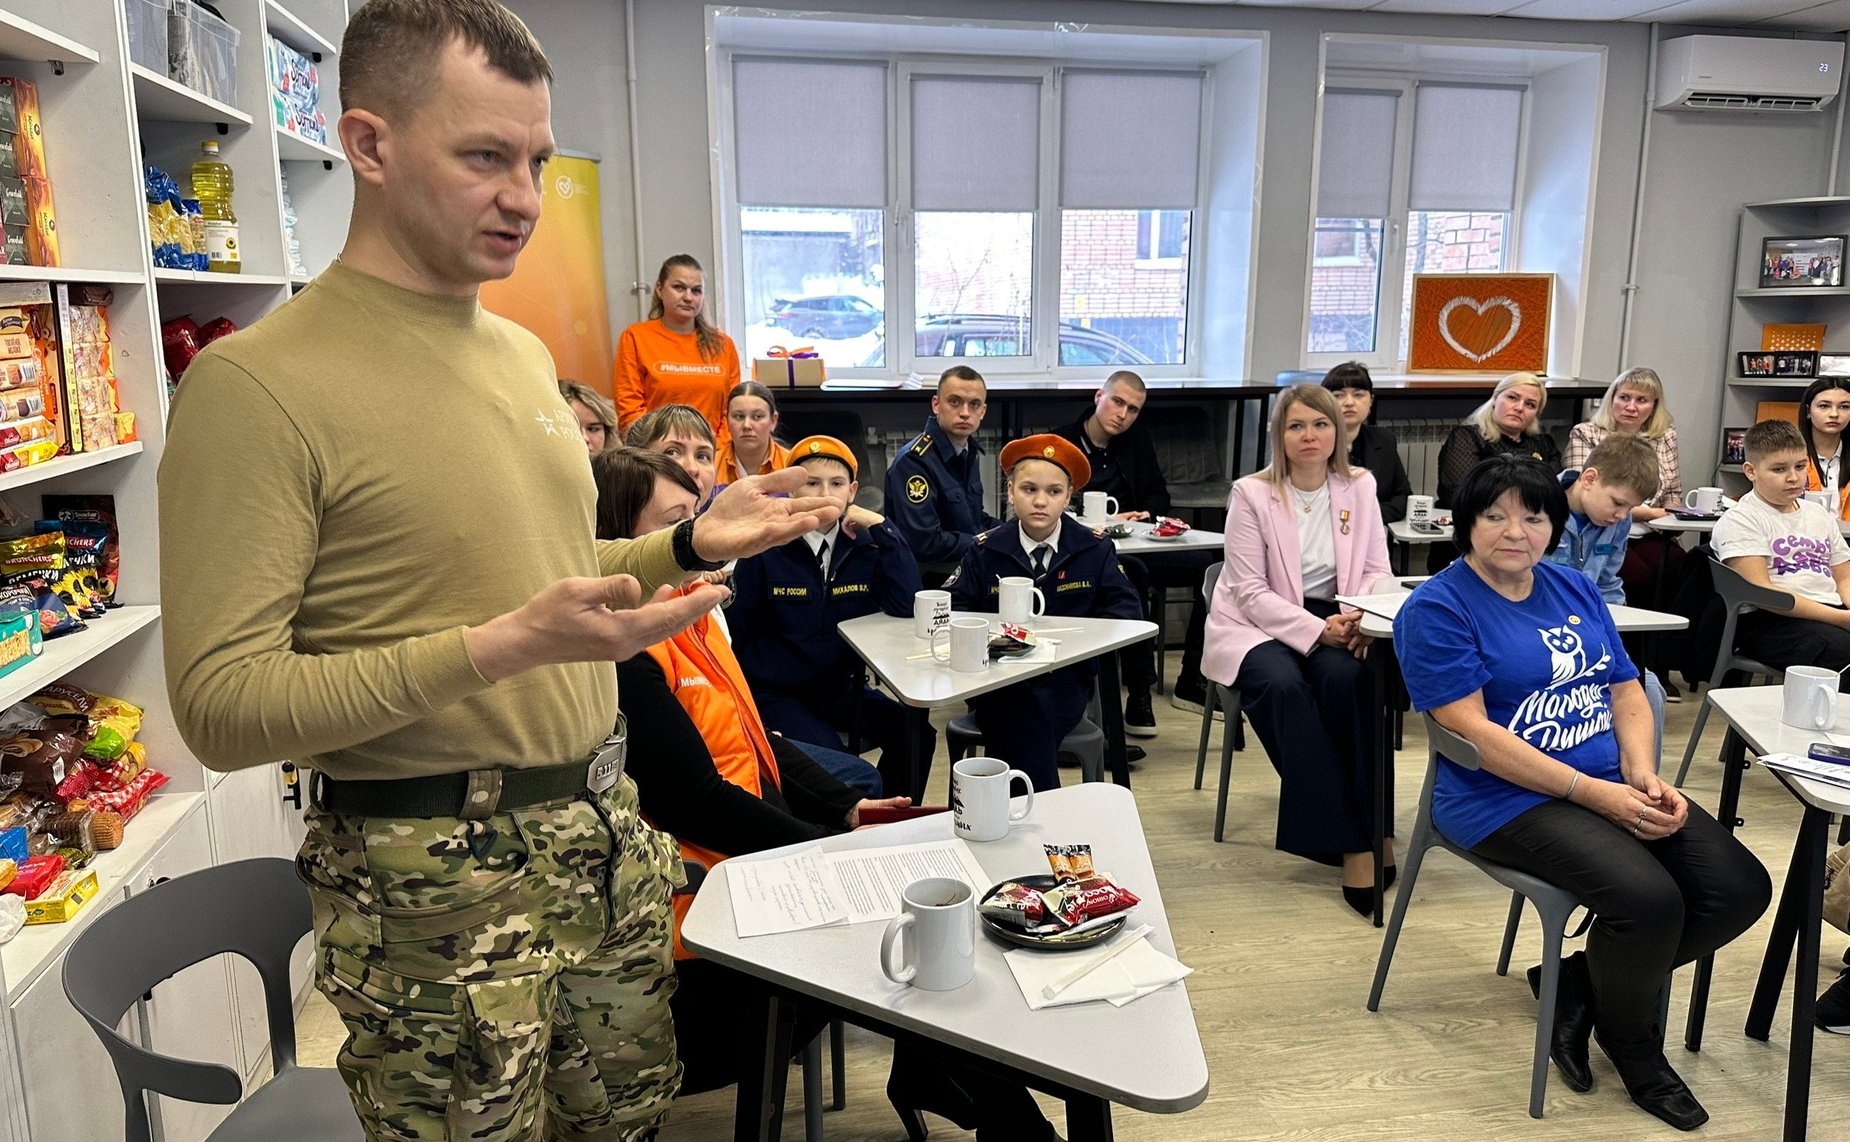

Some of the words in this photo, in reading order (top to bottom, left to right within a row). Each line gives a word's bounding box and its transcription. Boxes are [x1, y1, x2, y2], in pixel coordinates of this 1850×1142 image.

[1818, 63, 1829, 72] 23
[660, 364, 721, 374] #МЫВМЕСТЕ
[773, 587, 785, 596] МЧС
[786, 587, 807, 597] РОССИИ
[44, 685, 89, 713] АРУСЕЛИ
